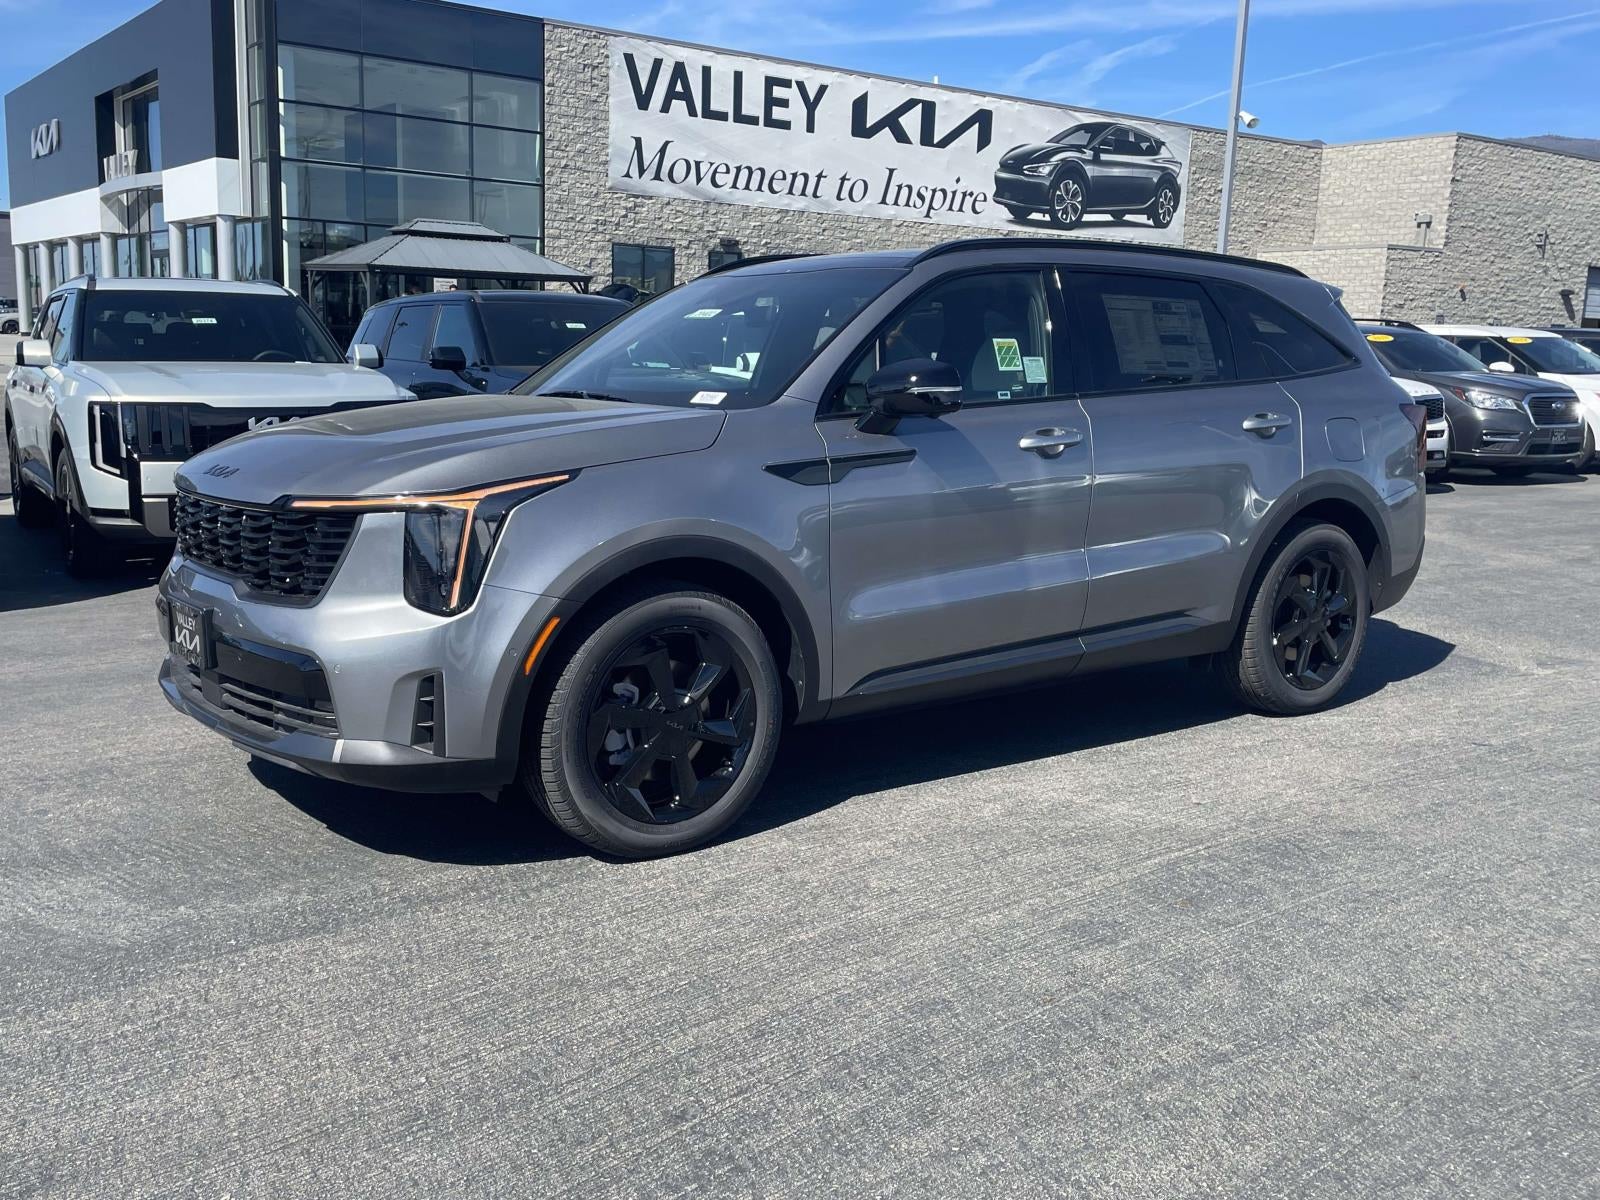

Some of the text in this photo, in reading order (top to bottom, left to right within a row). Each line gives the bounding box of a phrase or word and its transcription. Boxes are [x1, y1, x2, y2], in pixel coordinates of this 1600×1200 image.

[622, 52, 994, 154] VALLEY KIA
[30, 118, 60, 160] KIA
[620, 135, 989, 219] Movement to Inspire
[174, 624, 201, 653] KIA
[176, 611, 196, 631] VALLEY
